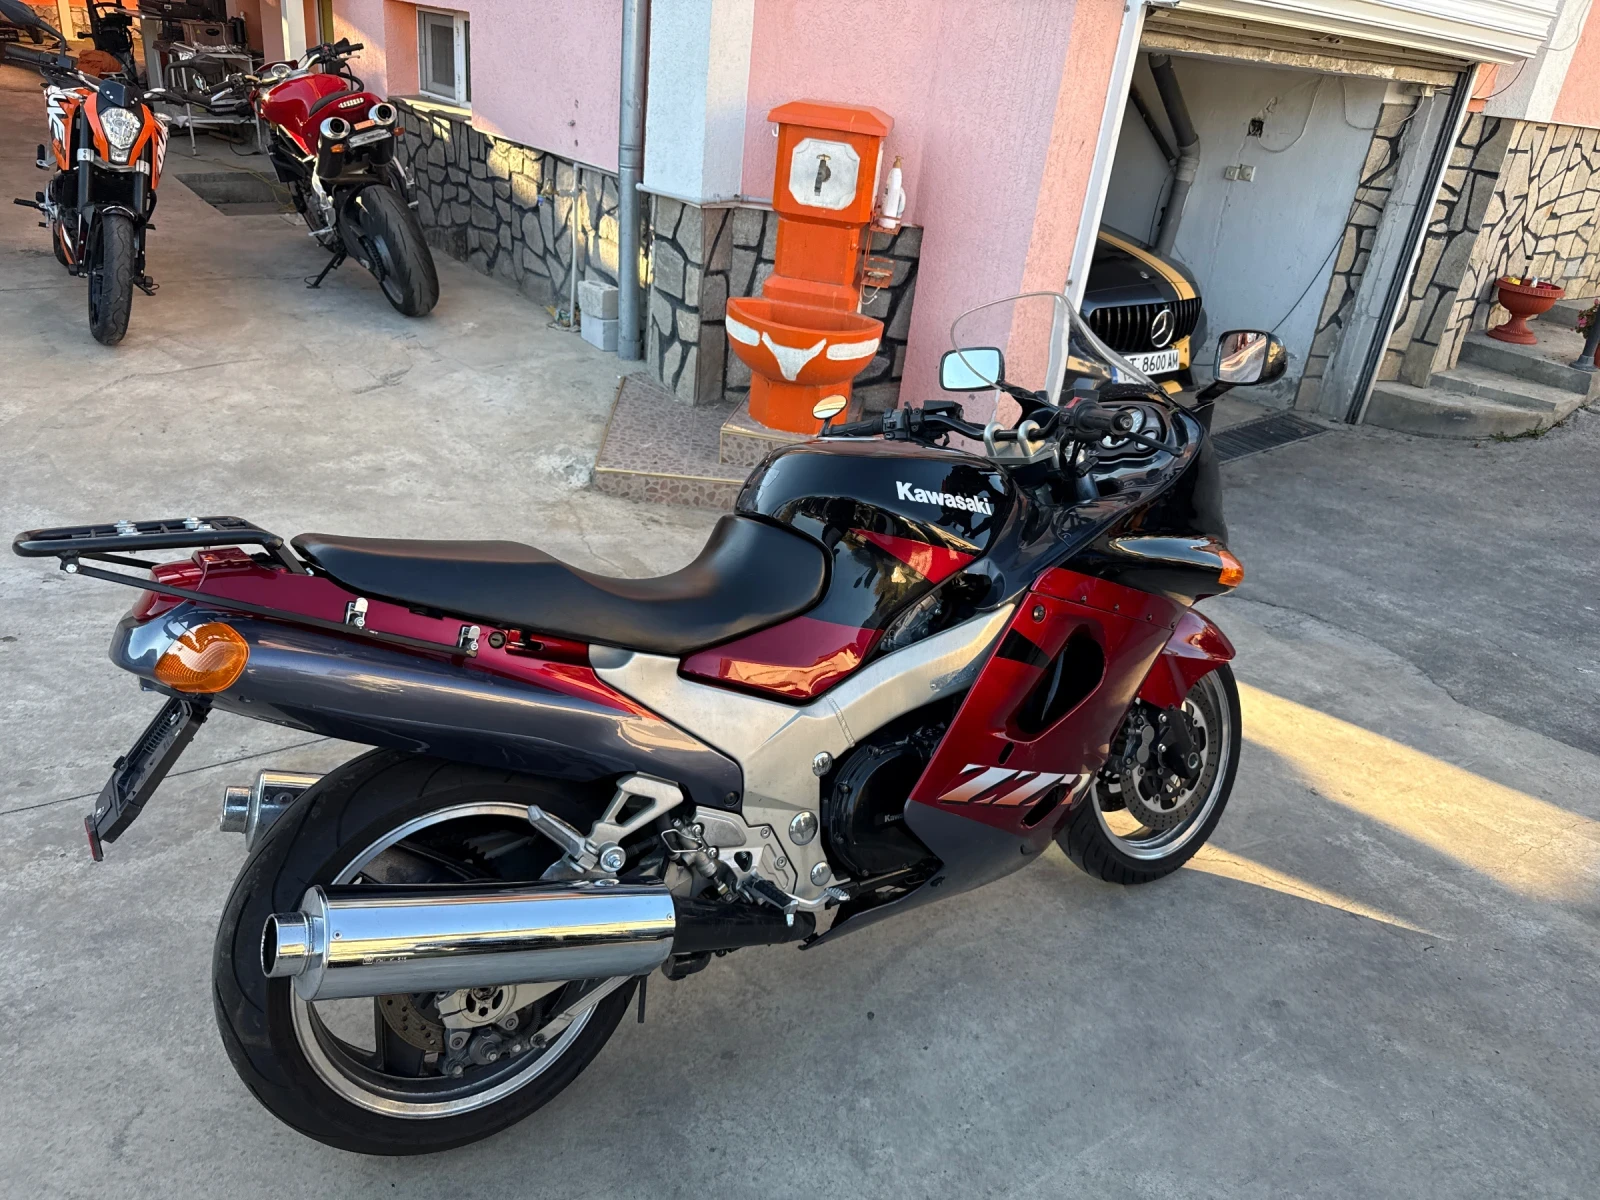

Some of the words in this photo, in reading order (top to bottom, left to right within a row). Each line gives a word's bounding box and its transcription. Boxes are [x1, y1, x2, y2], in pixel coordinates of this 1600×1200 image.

[1142, 354, 1166, 372] 8600
[1167, 351, 1178, 369] AM
[896, 480, 992, 516] Kawasaki
